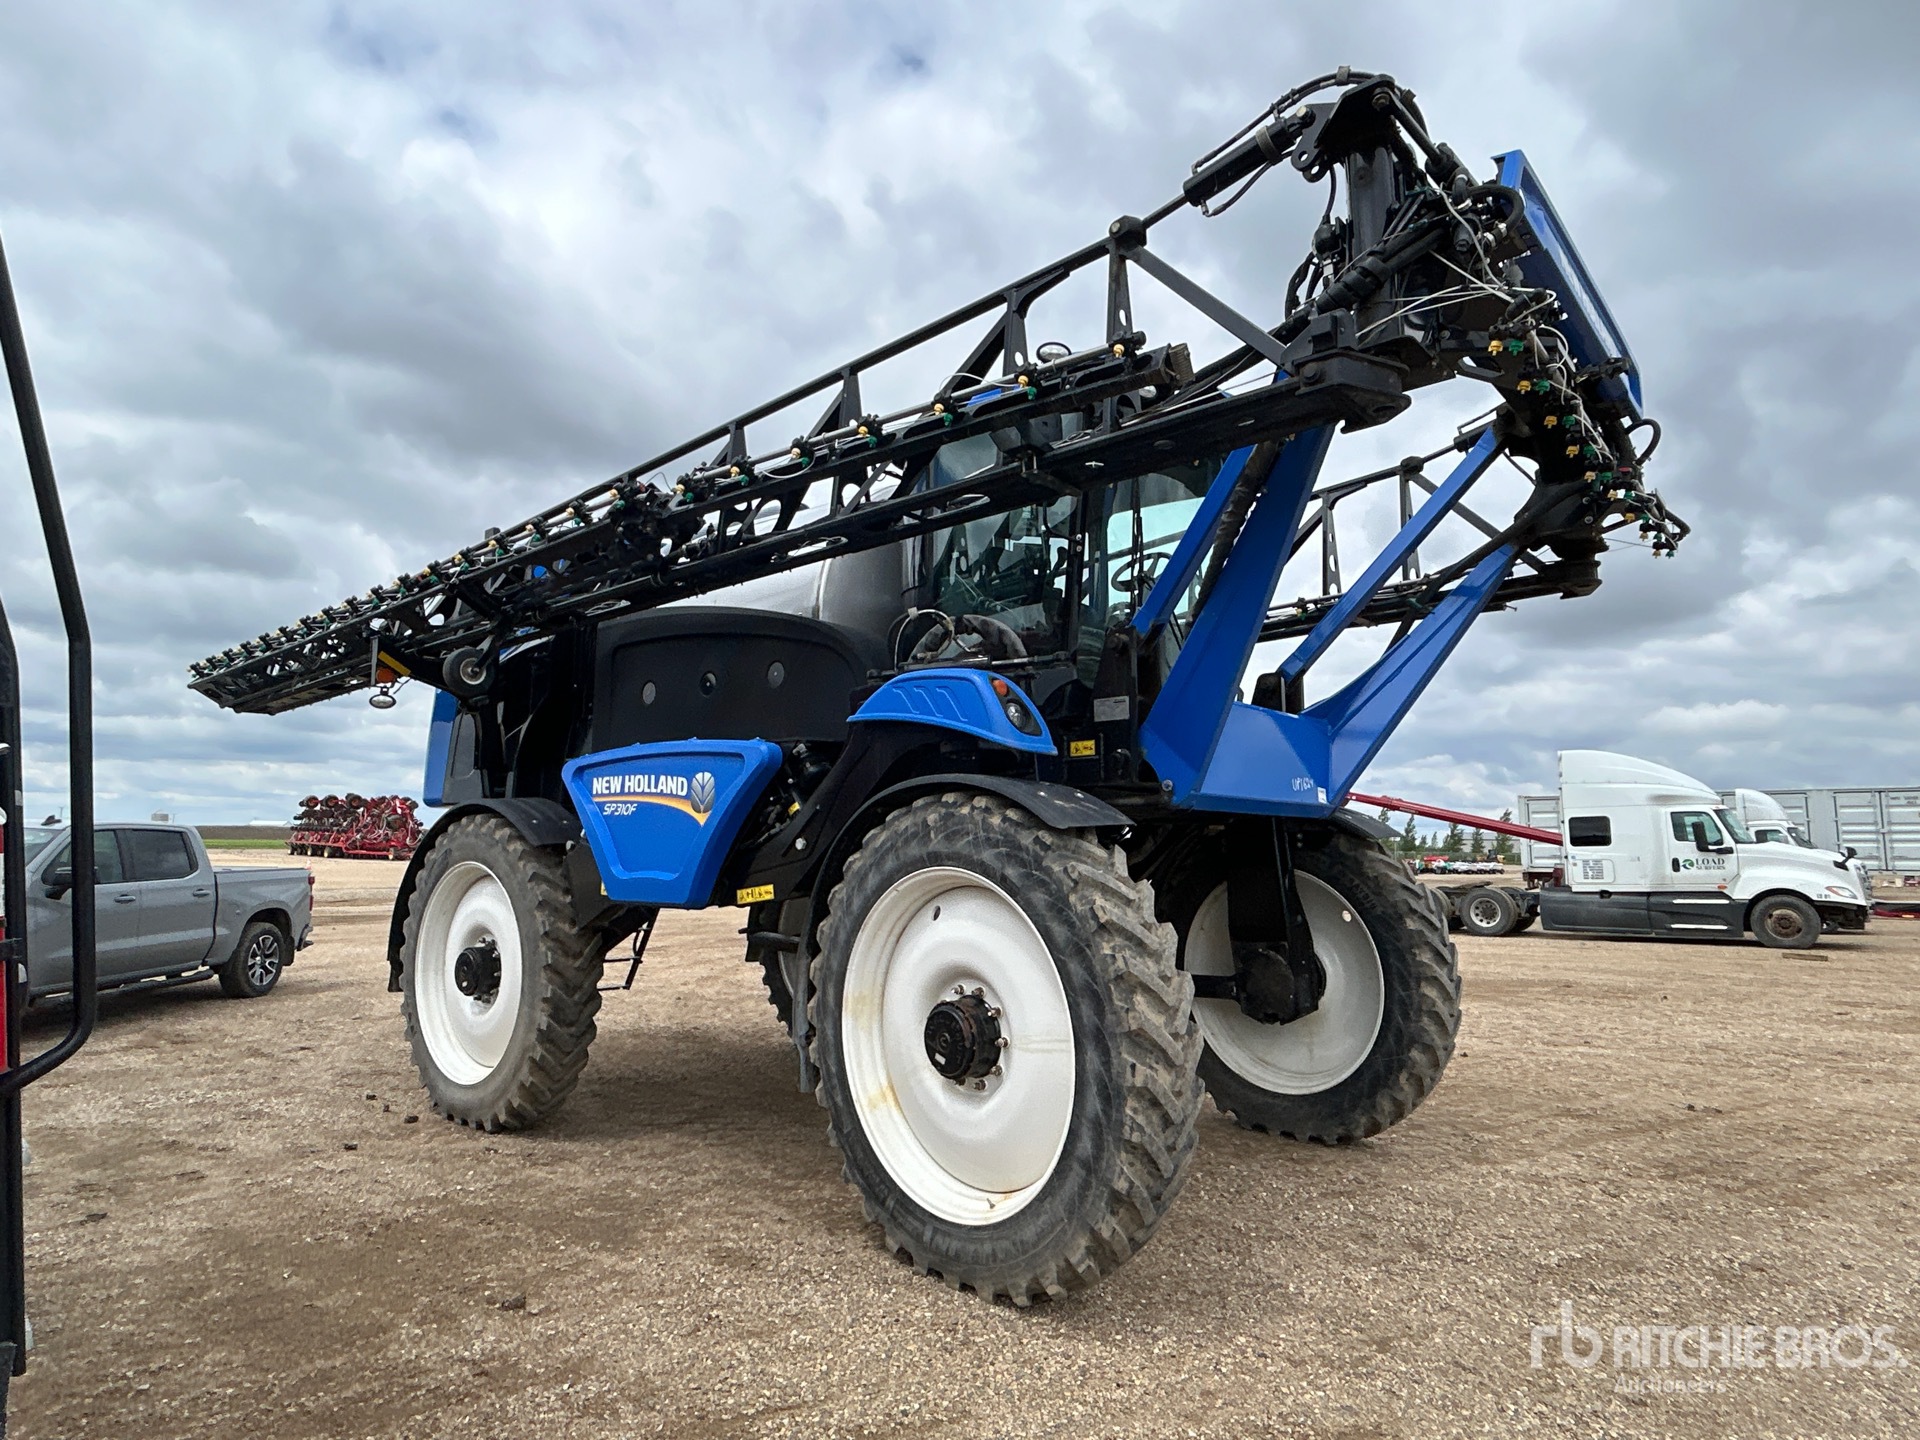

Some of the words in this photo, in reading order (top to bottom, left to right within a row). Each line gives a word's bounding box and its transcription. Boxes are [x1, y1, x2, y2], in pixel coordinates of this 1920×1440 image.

[592, 775, 623, 795] NEW
[624, 774, 688, 797] HOLLAND
[602, 803, 638, 816] SP310F
